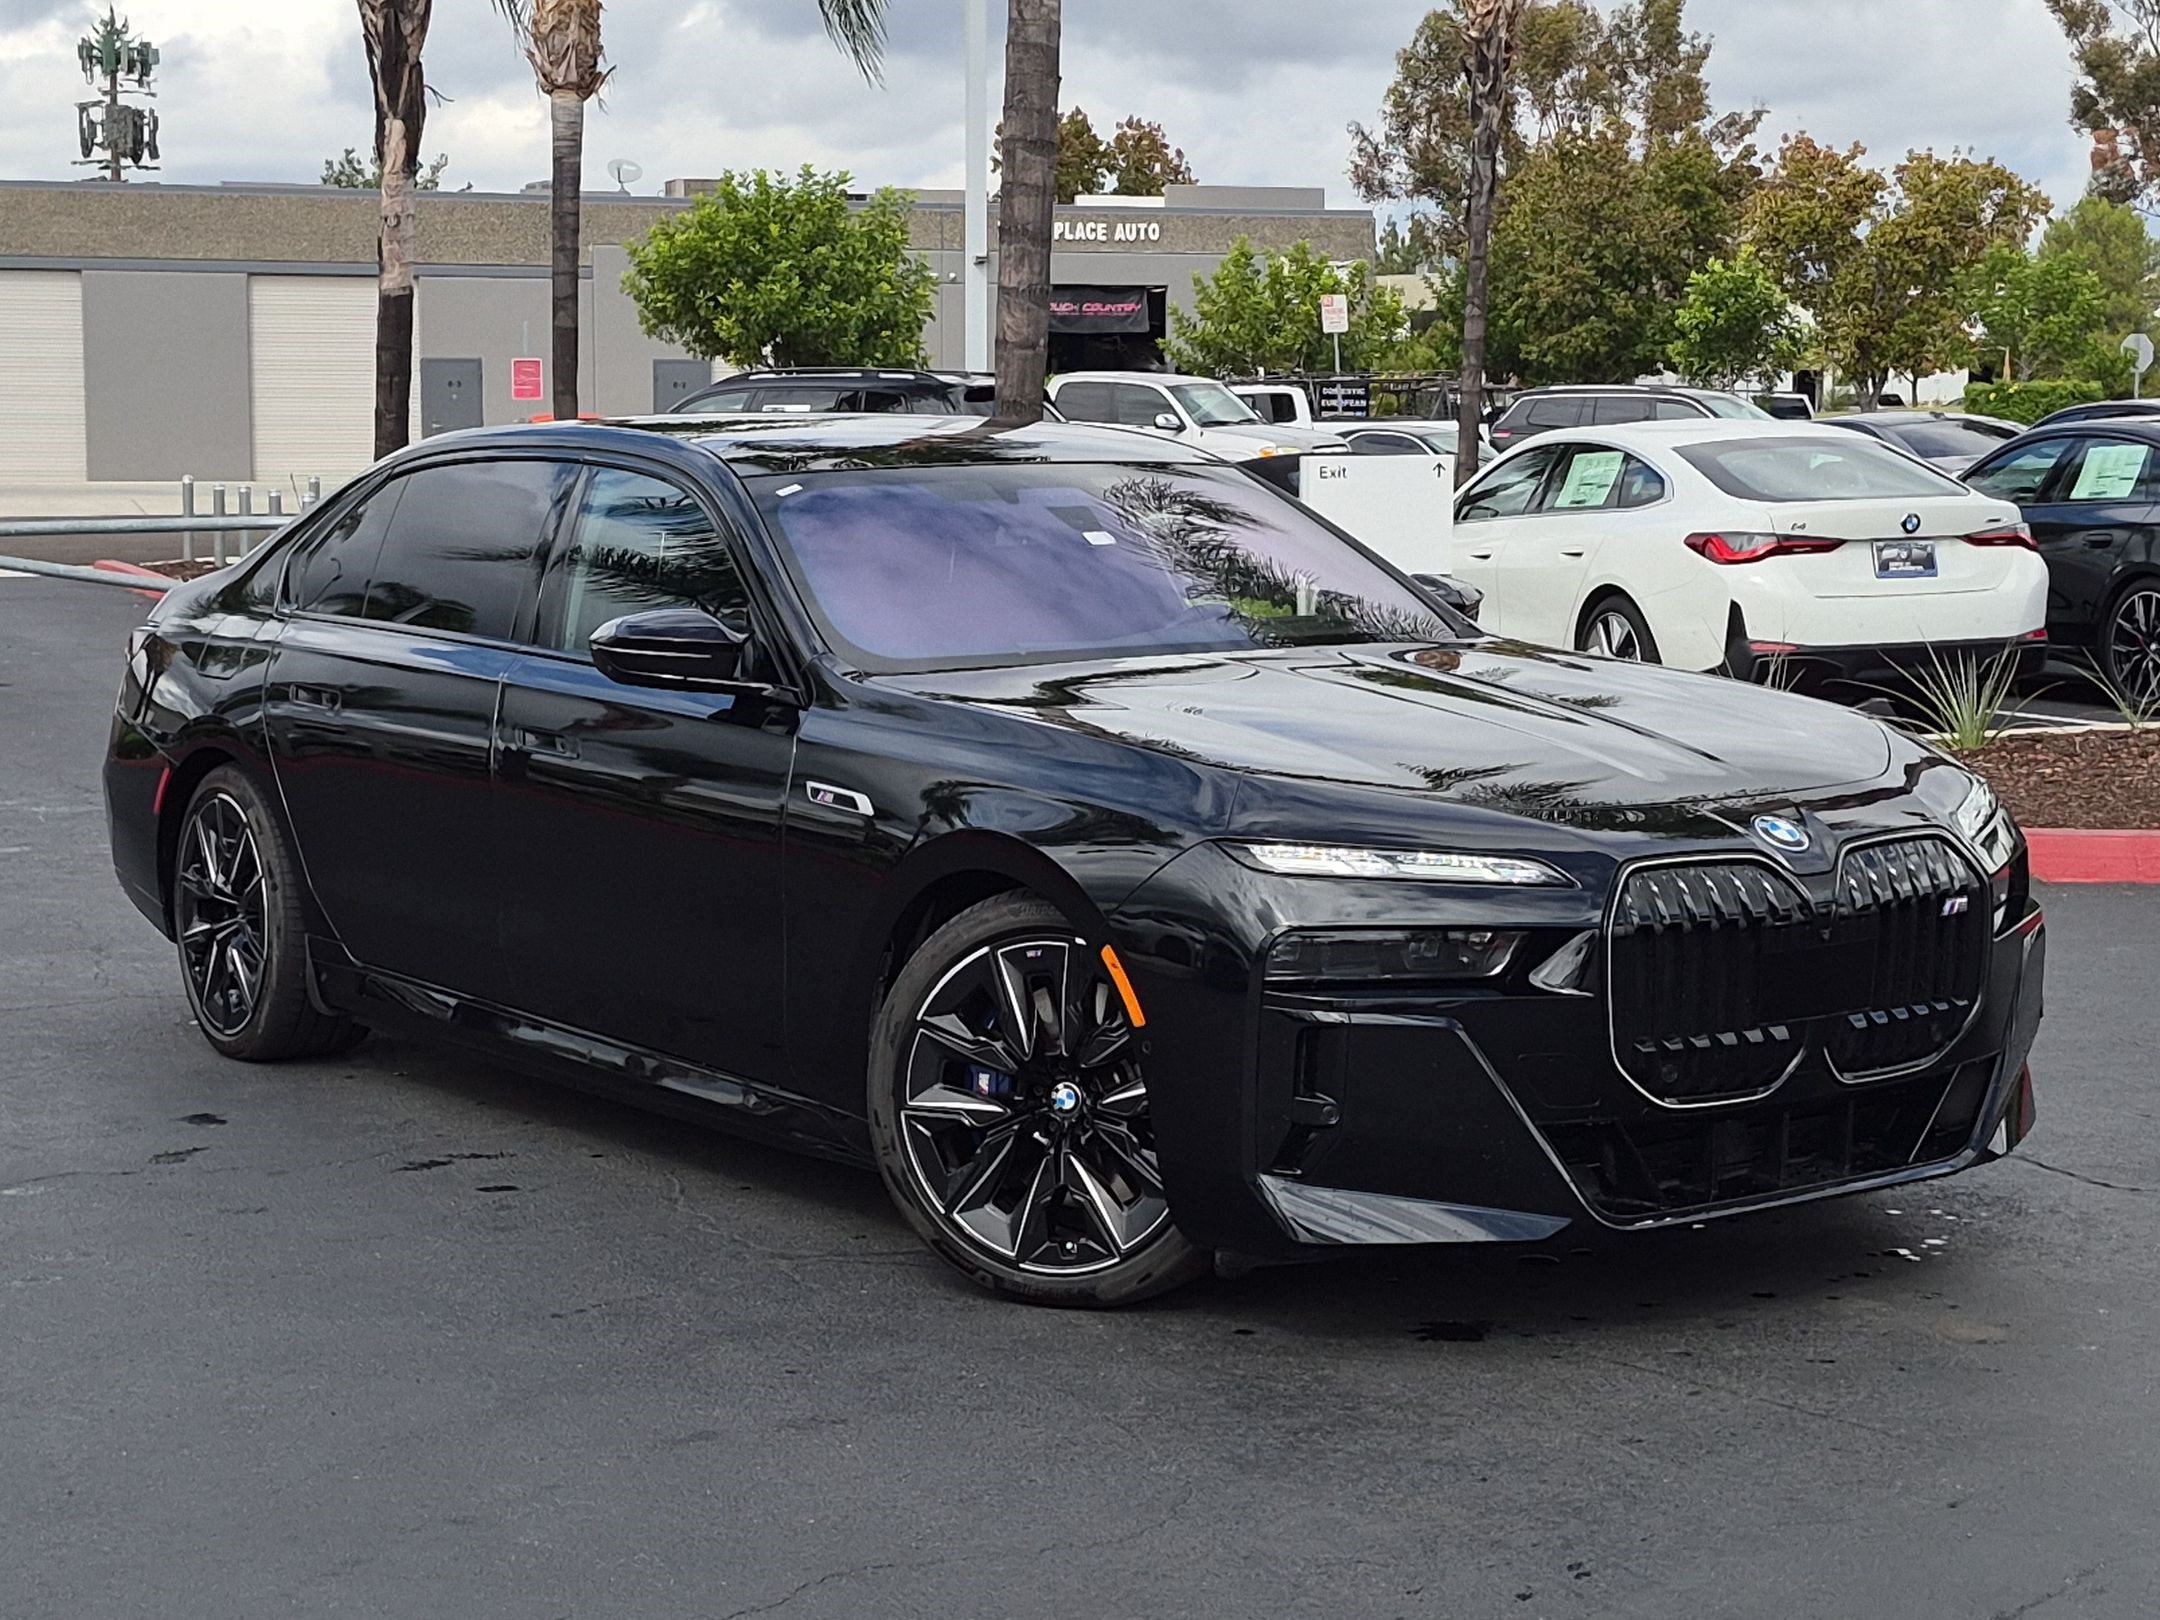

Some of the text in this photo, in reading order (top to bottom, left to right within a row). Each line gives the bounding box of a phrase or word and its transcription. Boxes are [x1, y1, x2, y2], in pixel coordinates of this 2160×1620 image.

[1053, 222, 1160, 242] PLACE AUTO
[1082, 302, 1141, 312] COUNTRY
[1319, 465, 1347, 479] Exit
